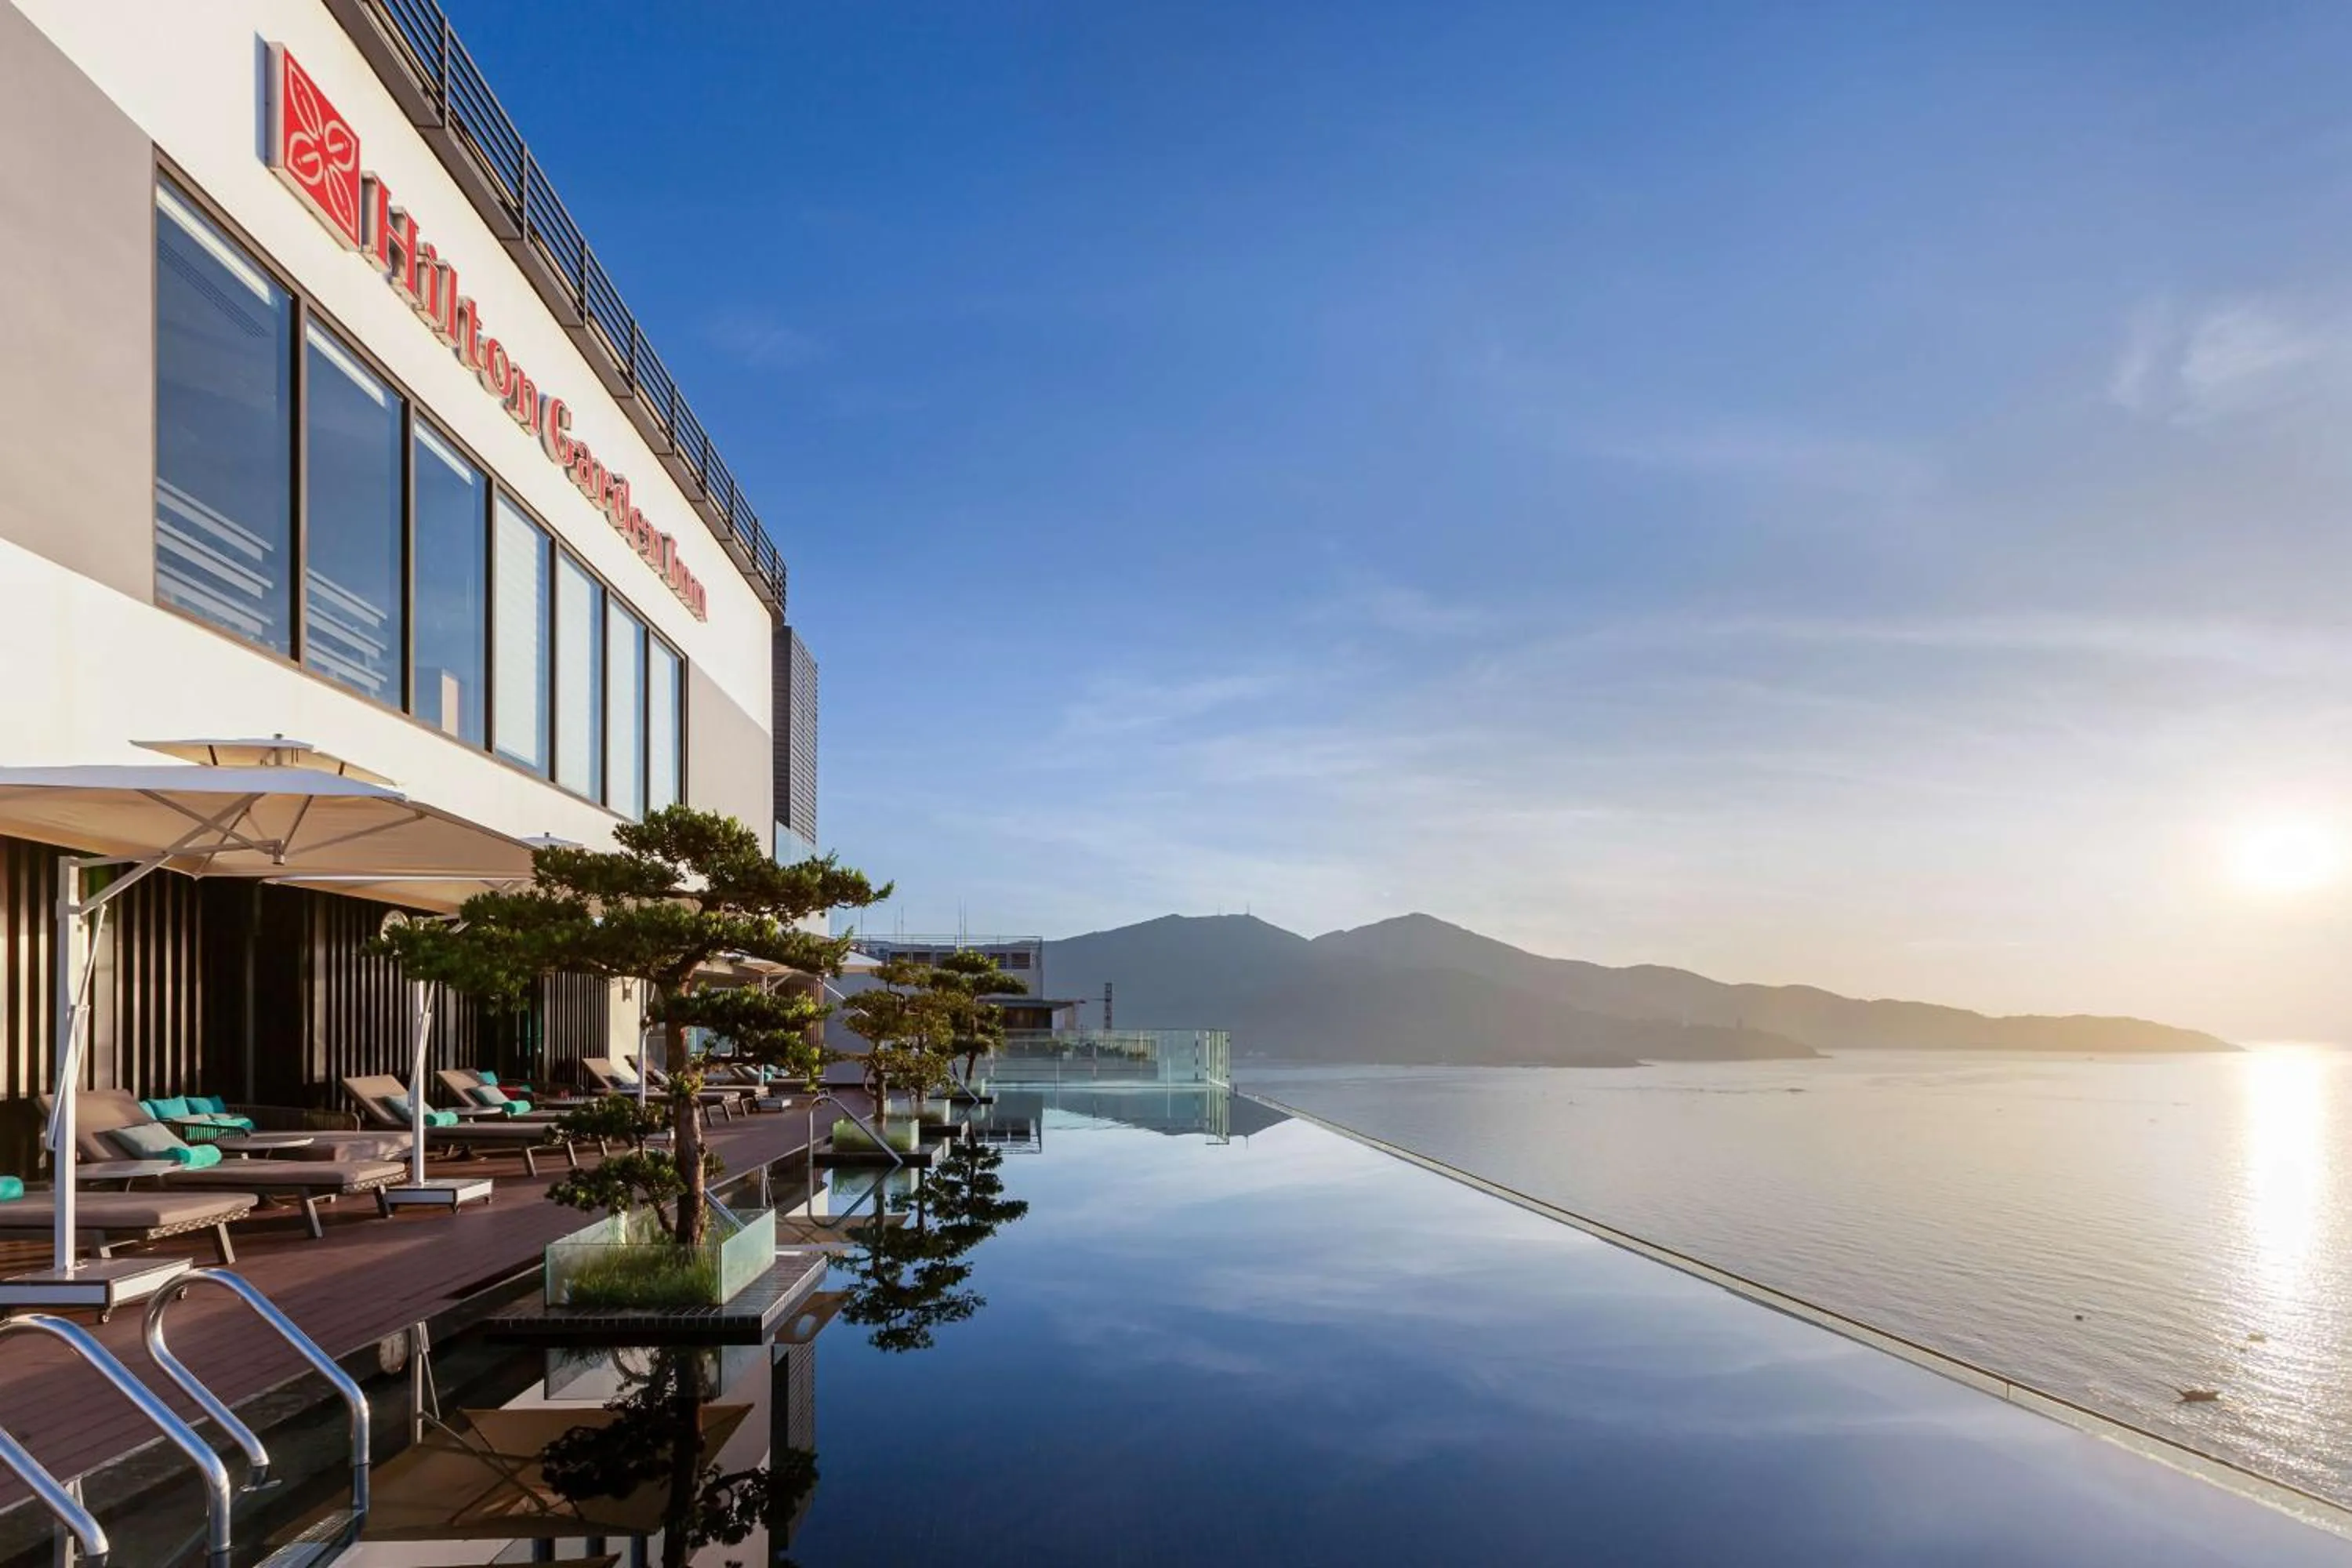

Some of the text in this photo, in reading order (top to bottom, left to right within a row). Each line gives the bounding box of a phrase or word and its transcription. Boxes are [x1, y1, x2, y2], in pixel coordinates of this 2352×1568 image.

[364, 172, 707, 622] Hilton Garden Inn
